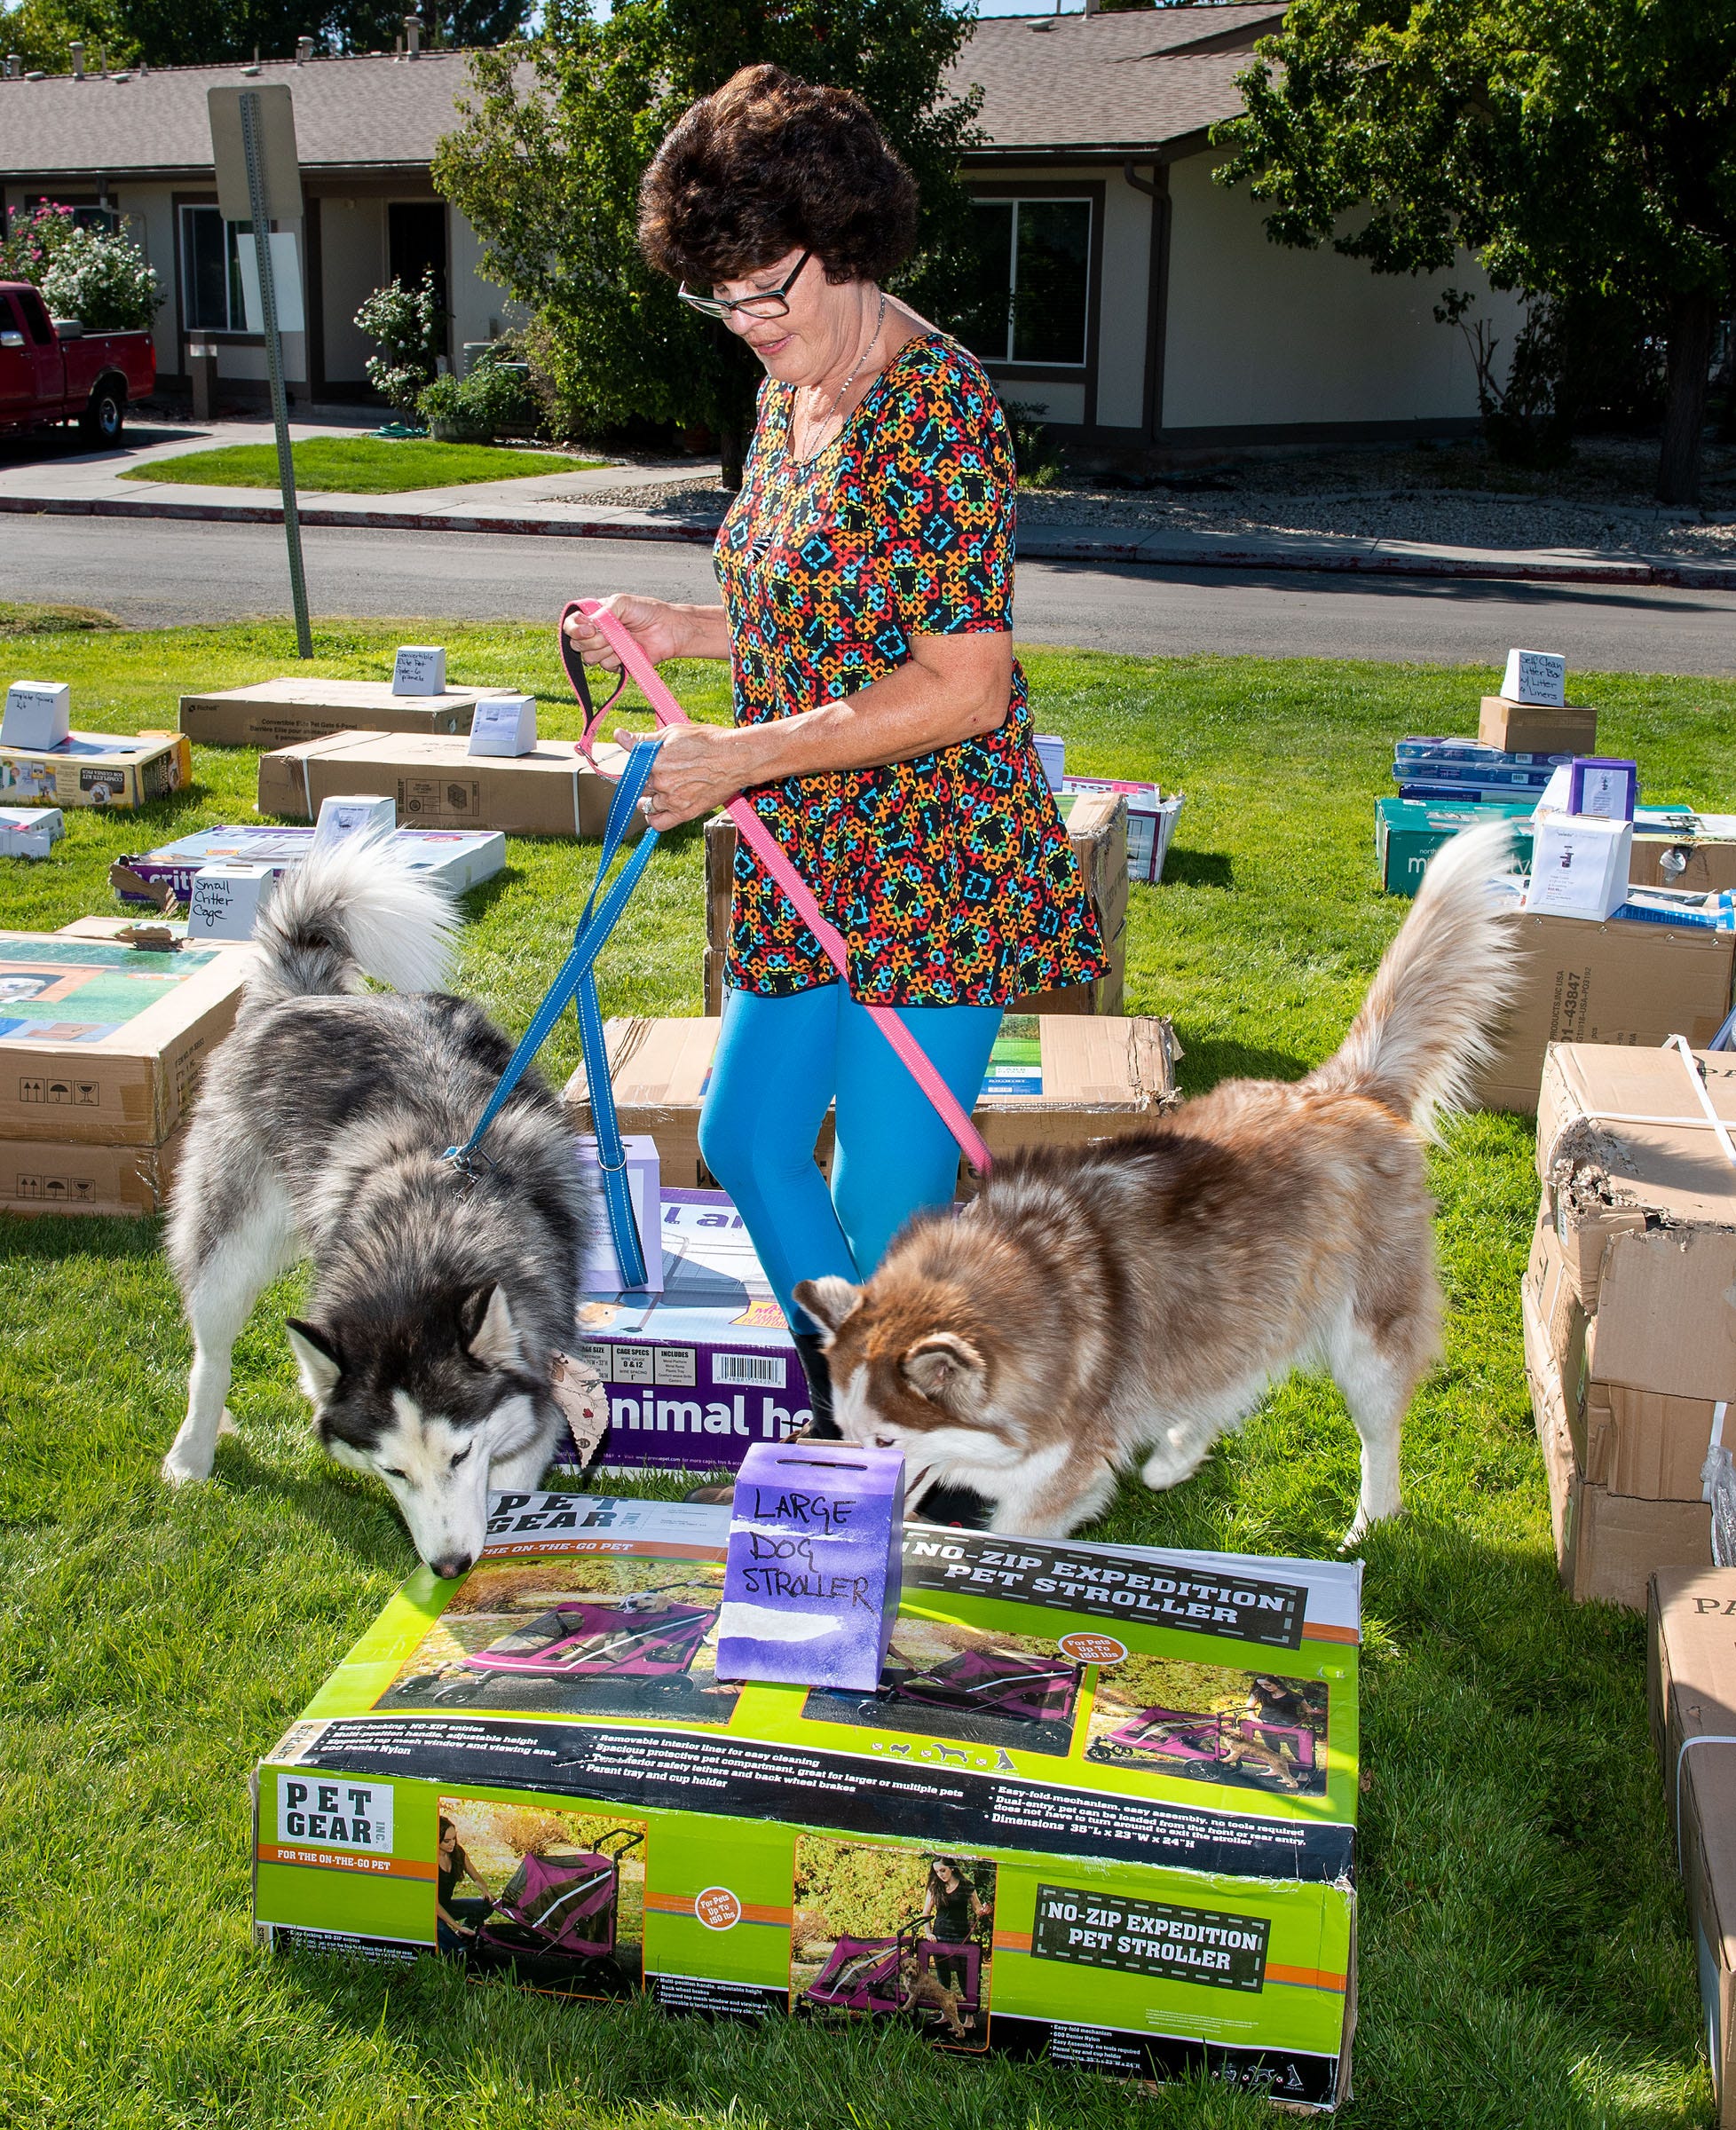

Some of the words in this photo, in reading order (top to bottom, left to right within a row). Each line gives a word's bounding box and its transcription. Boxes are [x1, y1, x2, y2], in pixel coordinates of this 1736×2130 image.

[1519, 654, 1537, 669] Self
[1539, 657, 1562, 671] Clean
[1521, 665, 1544, 676] Litter
[1528, 686, 1557, 699] Liners
[1532, 676, 1557, 688] Litter
[195, 879, 230, 894] Small
[195, 891, 234, 905] Critter
[193, 904, 227, 927] Cage
[612, 1390, 749, 1436] nimal
[492, 1495, 629, 1517] PET
[754, 1487, 856, 1535] LARGE
[486, 1511, 618, 1534] GEAR
[511, 1542, 597, 1553] ON-THE-GO
[600, 1542, 634, 1551] PET
[749, 1531, 818, 1573] DOG
[911, 1541, 1043, 1570] NO-ZIP
[1051, 1562, 1285, 1612] EXPEDITION
[742, 1567, 879, 1617] STROLLER
[944, 1564, 1024, 1587] PET
[1031, 1578, 1238, 1624] STROLLER
[380, 1746, 410, 1755] Nylon
[424, 1740, 462, 1748] window
[490, 1743, 531, 1755] viewing
[533, 1748, 556, 1757] area
[446, 1732, 494, 1742] adjustable
[499, 1736, 538, 1747] height
[600, 1733, 659, 1745] Removable
[660, 1738, 698, 1748] interior
[702, 1743, 726, 1753] liner
[728, 1747, 742, 1755] for
[745, 1749, 769, 1761] easy
[772, 1753, 820, 1770] cleaning
[587, 1763, 621, 1775] Parent
[623, 1768, 644, 1779] tray
[646, 1771, 667, 1780] and
[669, 1773, 689, 1785] cup
[692, 1776, 728, 1787] holder
[596, 1742, 645, 1755] Spacious
[646, 1748, 699, 1762] protective
[702, 1755, 719, 1764] pet
[798, 1768, 825, 1779] great
[828, 1771, 843, 1780] for
[846, 1774, 877, 1786] larger
[879, 1779, 891, 1787] or
[893, 1780, 936, 1795] multiple
[940, 1787, 964, 1799] pets
[657, 1760, 690, 1771] safety
[692, 1763, 729, 1775] tethers
[731, 1769, 751, 1778] and
[754, 1771, 781, 1782] back
[784, 1776, 817, 1787] wheel
[819, 1780, 856, 1794] brakes
[287, 1782, 372, 1816] PET
[991, 1812, 1064, 1830] Dimensions
[998, 1786, 1050, 1802] Easy-fold
[1124, 1805, 1150, 1817] easy
[1228, 1821, 1254, 1831] tools
[1258, 1825, 1304, 1838] required
[1059, 1805, 1077, 1815] pet
[1079, 1808, 1100, 1818] can
[1103, 1810, 1117, 1819] be
[1119, 1813, 1156, 1826] loaded
[1160, 1819, 1185, 1829] from
[1188, 1823, 1205, 1833] the
[1208, 1826, 1234, 1836] front
[1236, 1830, 1248, 1839] or
[1251, 1833, 1273, 1842] rear
[287, 1812, 372, 1844] GEAR
[277, 1850, 296, 1860] FOR
[298, 1851, 317, 1862] THE
[320, 1854, 369, 1868] ON-THE-GO
[371, 1860, 391, 1871] PET
[700, 1899, 713, 1909] For
[713, 1894, 730, 1904] Pets
[708, 1907, 719, 1916] Up
[709, 1914, 722, 1924] 150
[724, 1910, 736, 1920] lbs
[1047, 1901, 1122, 1928] NO-ZIP
[1126, 1913, 1258, 1951] EXPEDITION
[1069, 1928, 1112, 1950] PET
[1117, 1936, 1231, 1970] STROLLER
